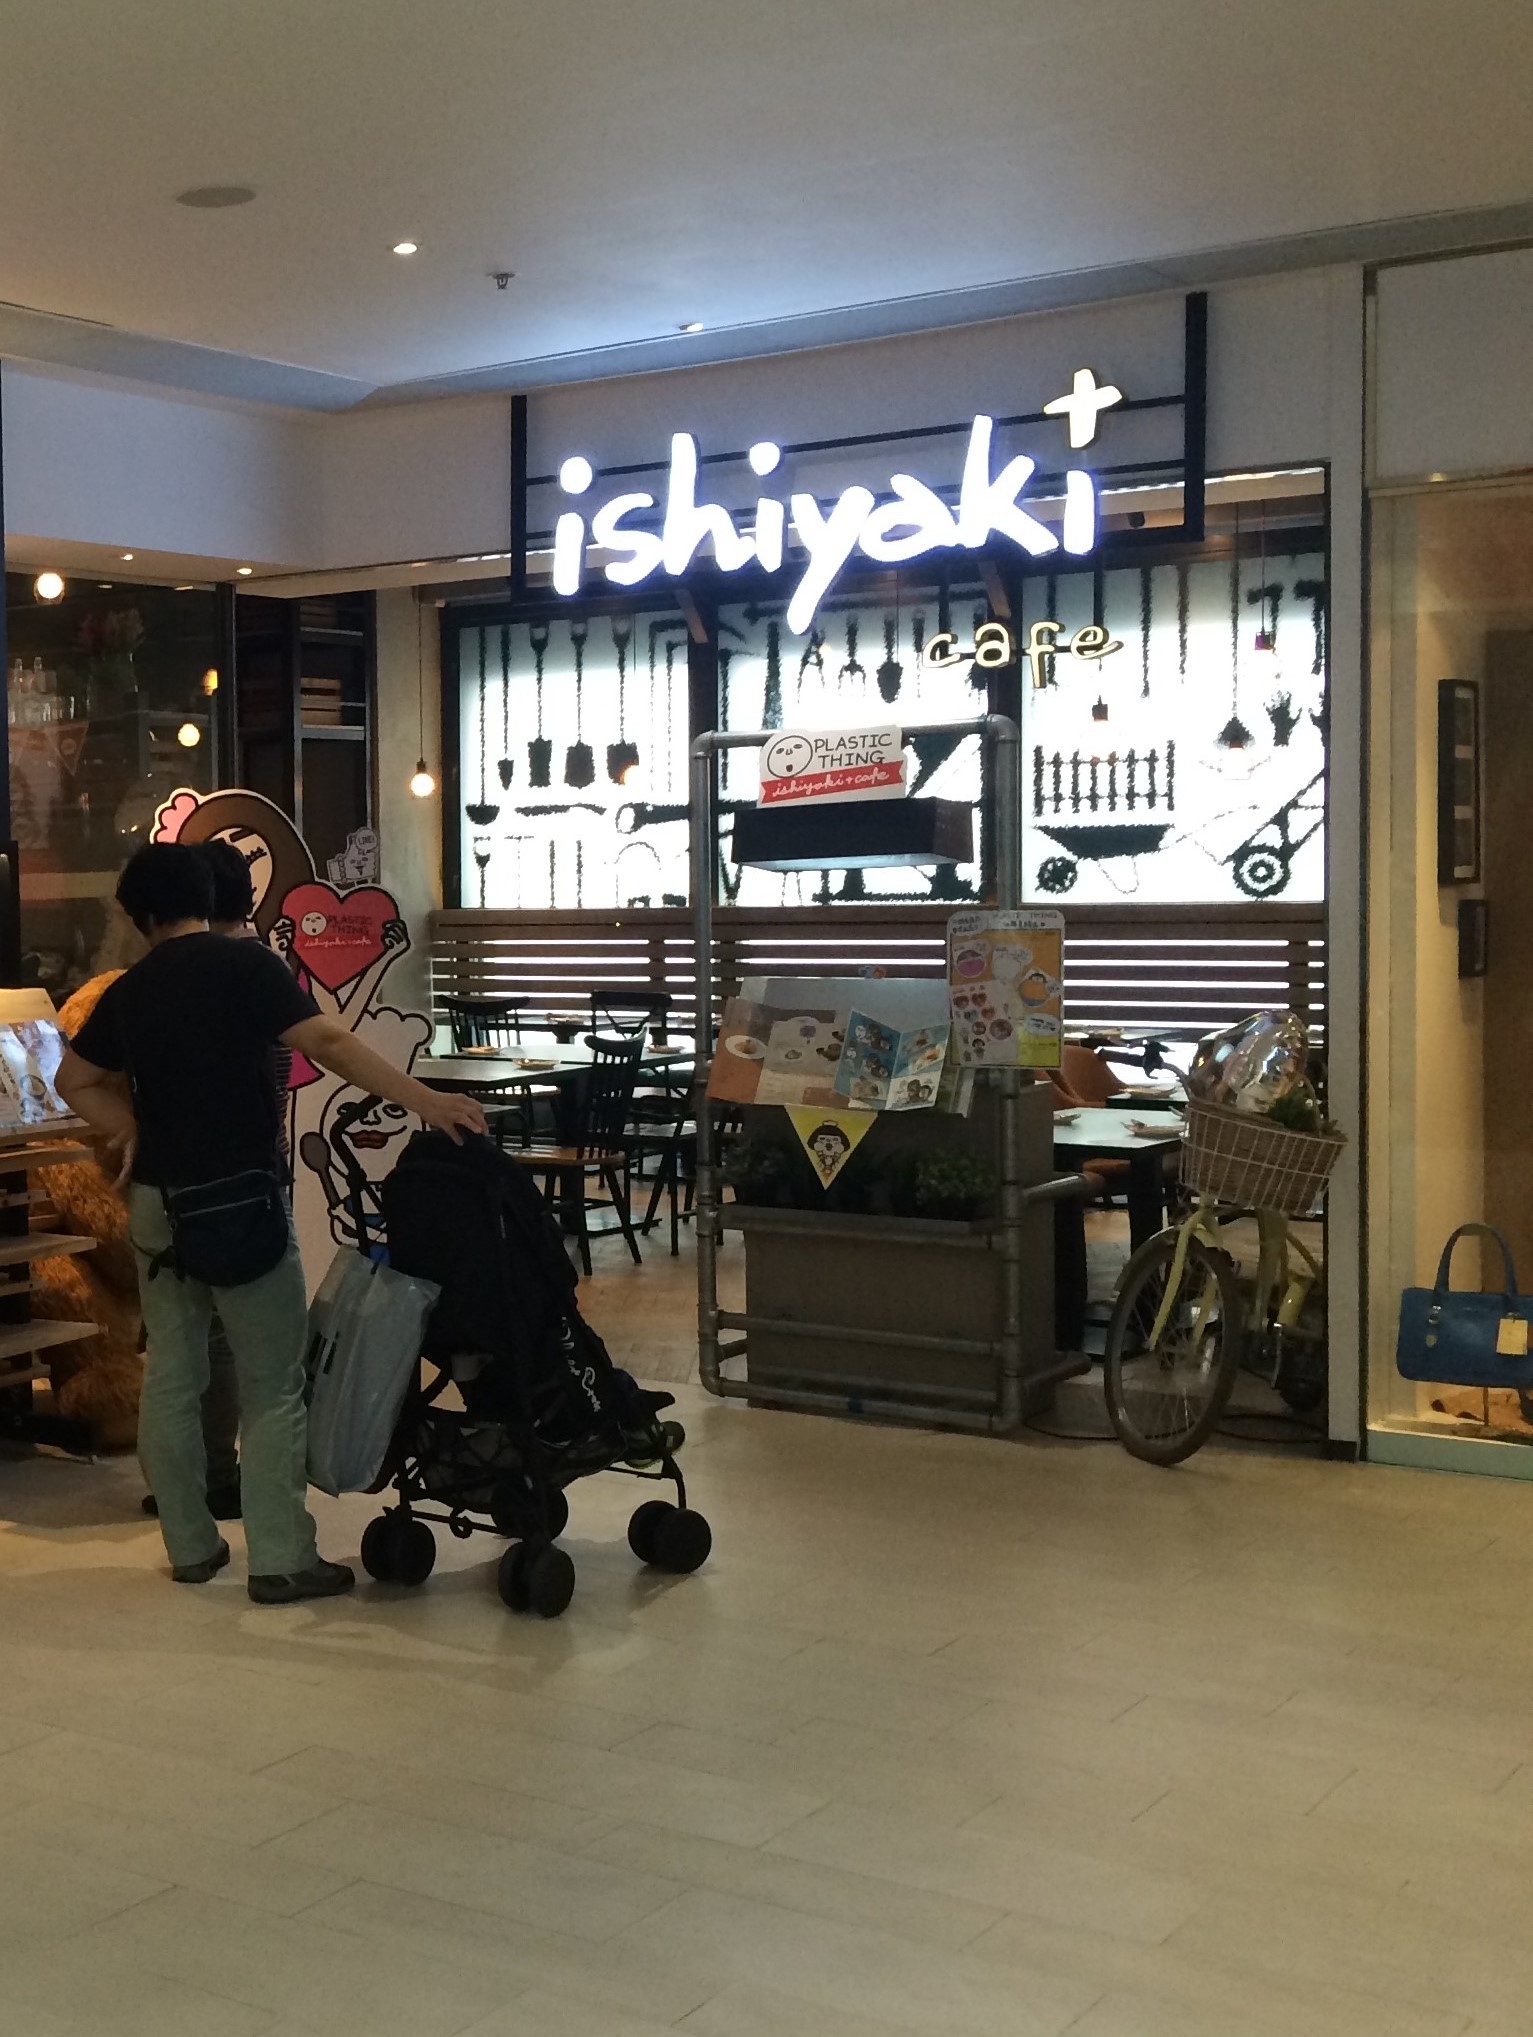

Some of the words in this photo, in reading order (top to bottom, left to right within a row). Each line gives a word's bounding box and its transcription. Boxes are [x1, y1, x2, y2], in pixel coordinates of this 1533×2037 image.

[922, 621, 1123, 689] cafe
[813, 733, 893, 753] PLASTIC
[818, 750, 885, 769] THING
[331, 925, 370, 936] THING
